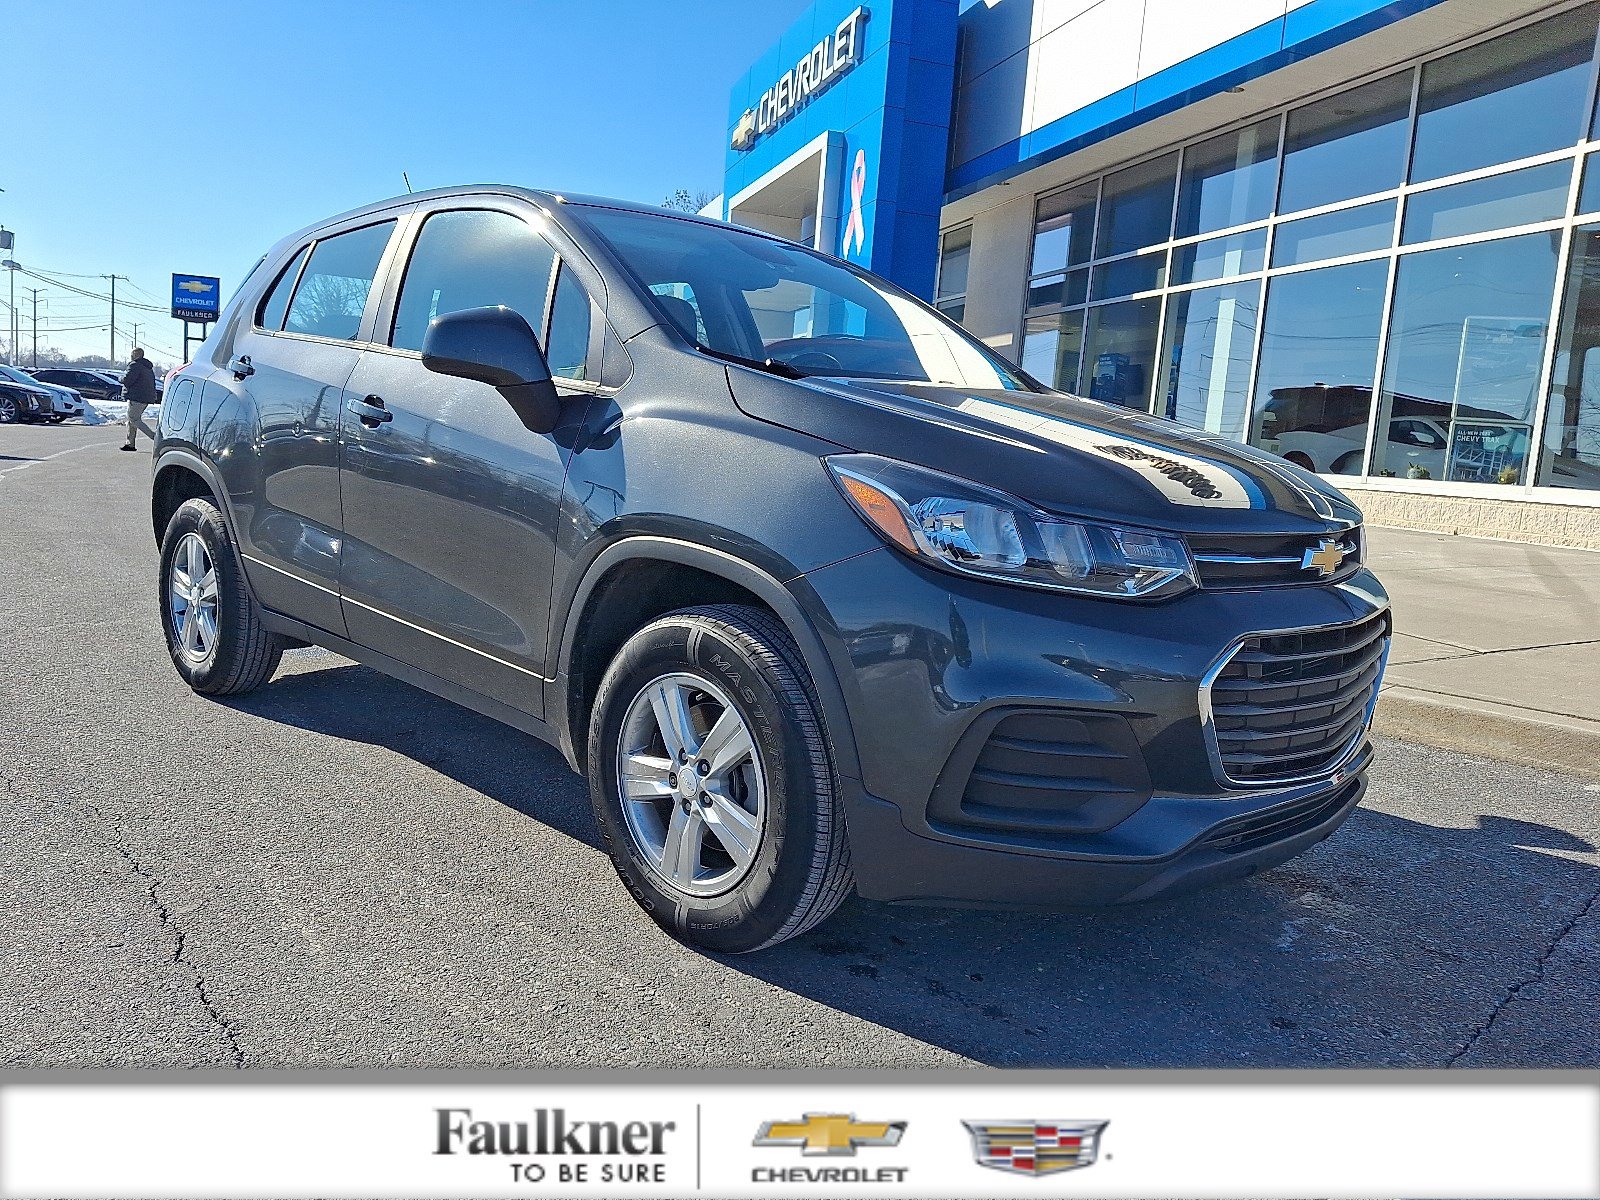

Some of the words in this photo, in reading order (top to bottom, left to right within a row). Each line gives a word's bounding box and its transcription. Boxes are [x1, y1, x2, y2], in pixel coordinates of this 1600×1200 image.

[758, 5, 864, 134] CHEVROLET
[175, 297, 215, 306] CHEVROLET
[177, 309, 213, 318] FAULKNER
